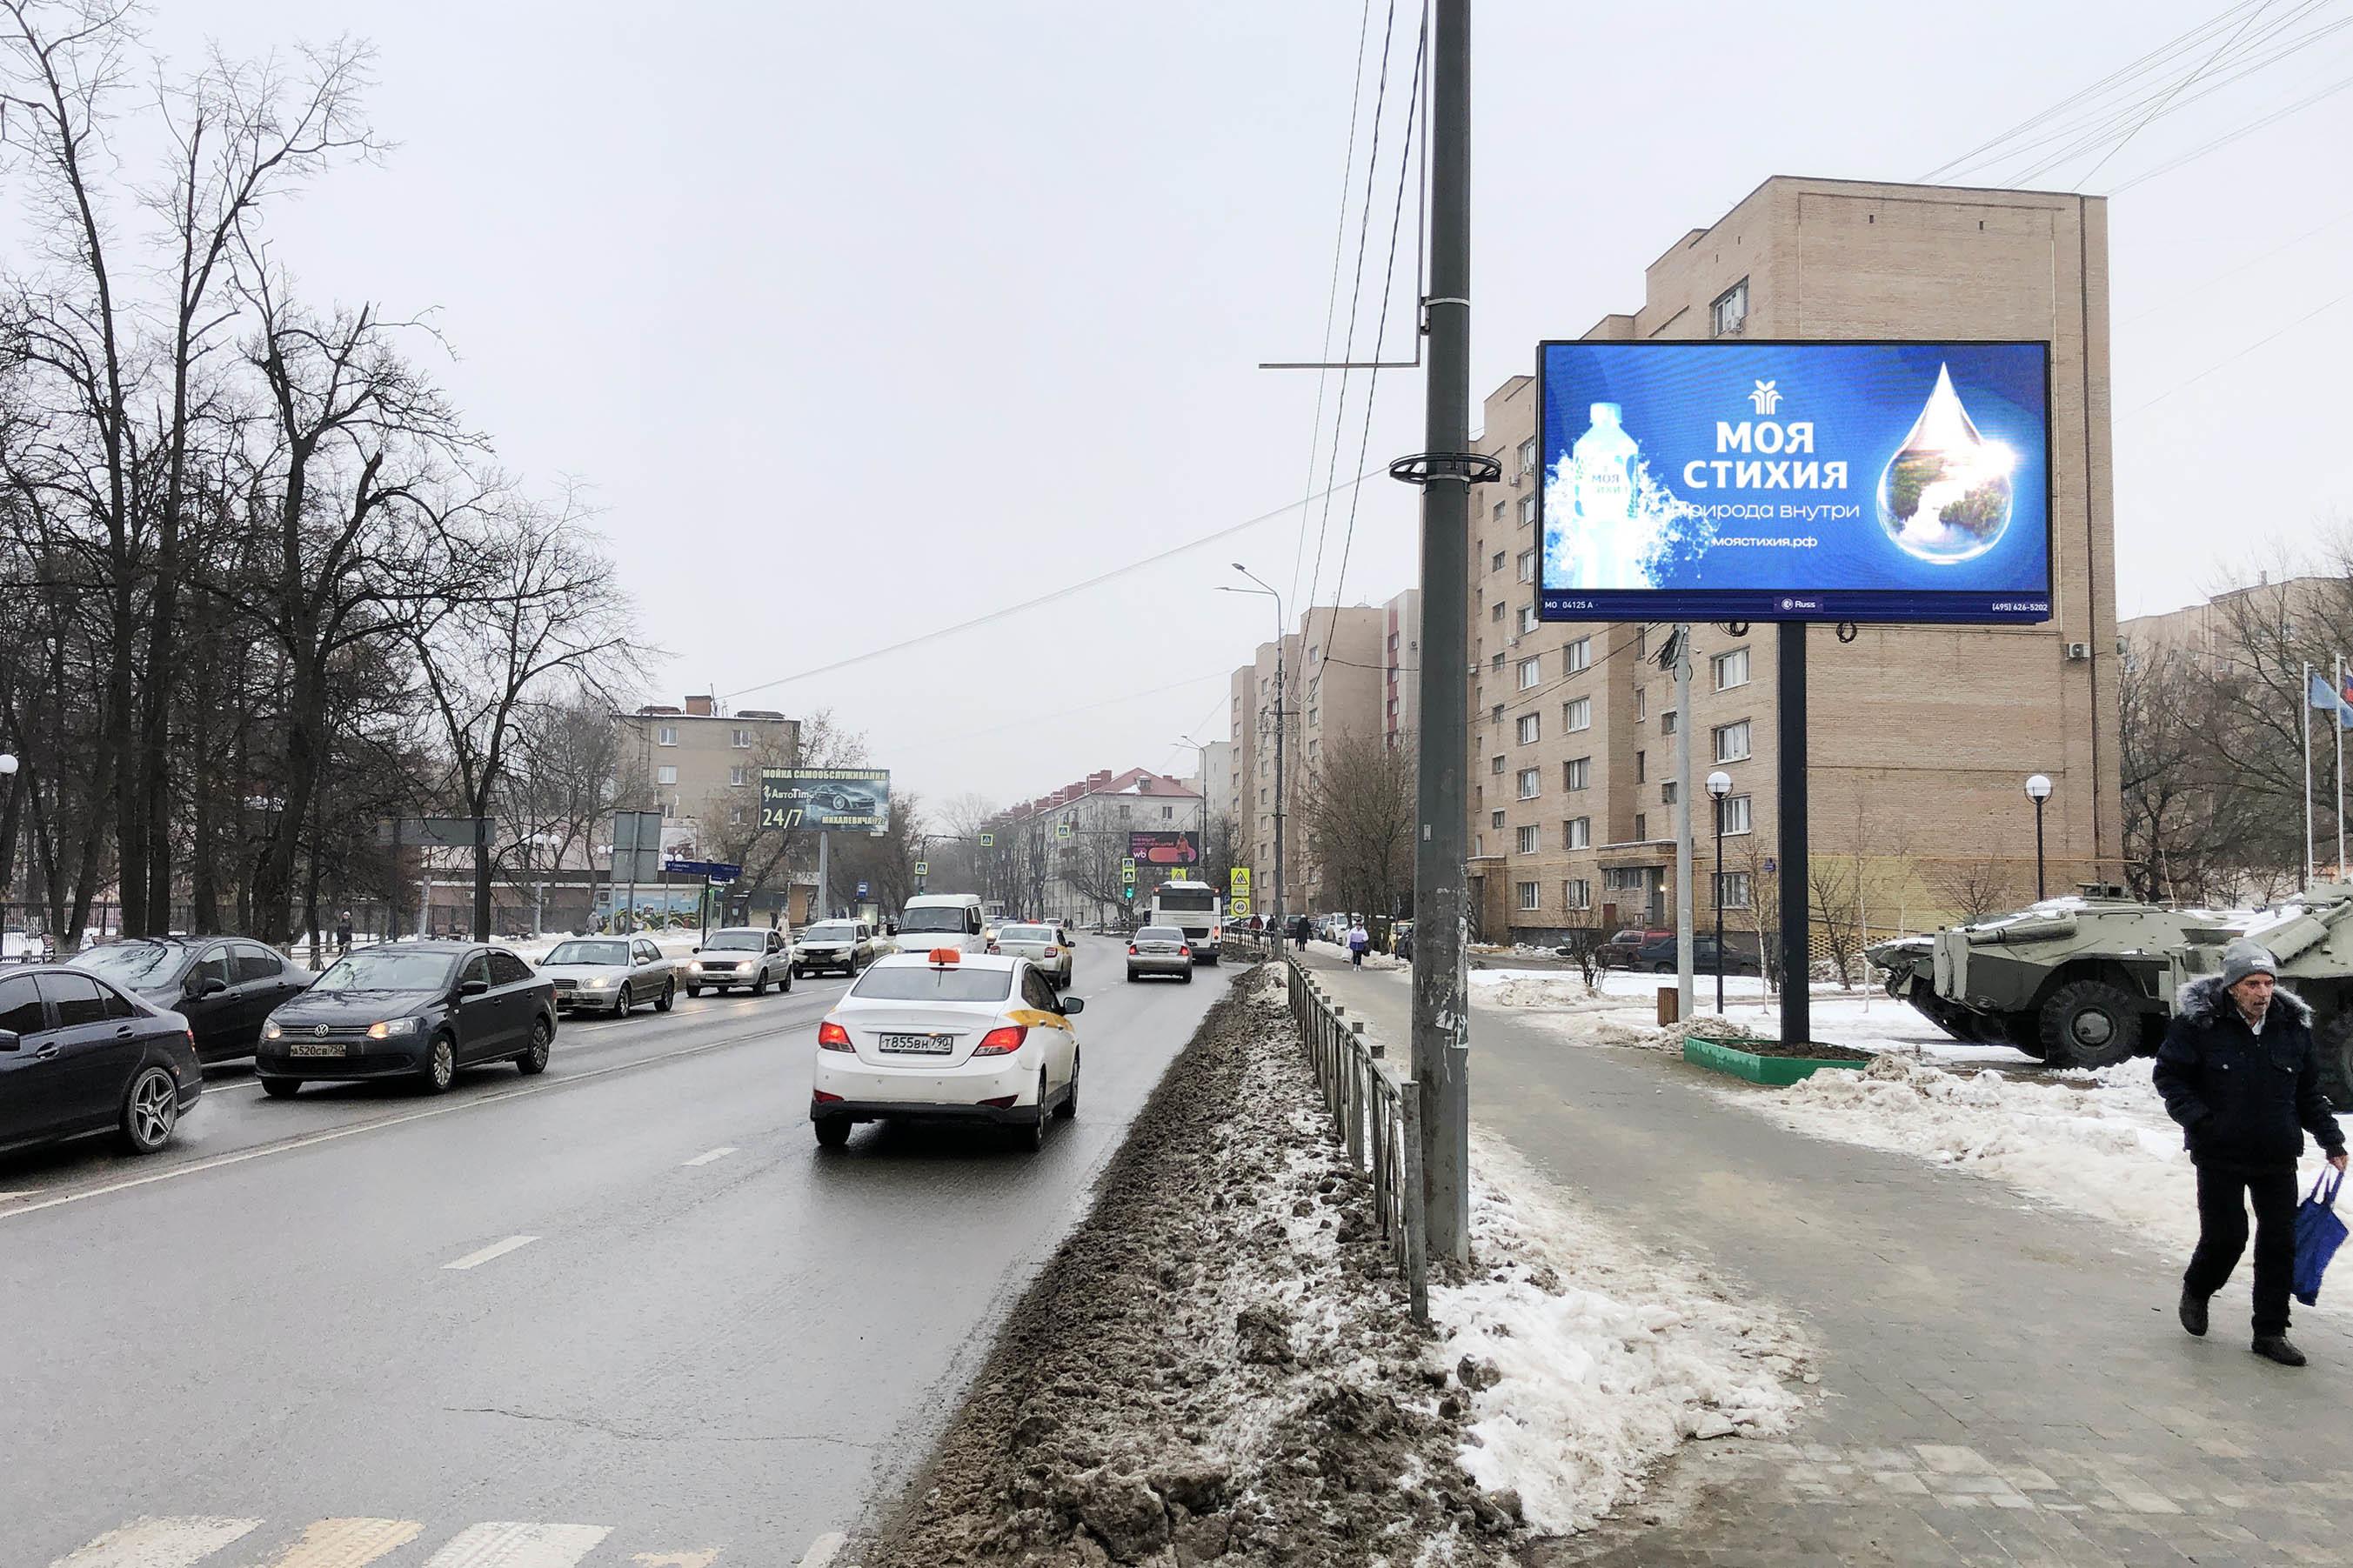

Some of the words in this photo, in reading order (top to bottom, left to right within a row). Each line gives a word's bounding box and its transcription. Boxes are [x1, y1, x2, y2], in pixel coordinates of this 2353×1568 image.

[1716, 421, 1814, 454] МОЯ
[1592, 474, 1620, 484] МОЯ
[1683, 460, 1848, 489] СТИХИЯ
[1683, 504, 1775, 522] рирода
[1780, 504, 1860, 522] внутри
[1713, 535, 1818, 549] моястихия.рф
[1992, 603, 2011, 611] (495)
[762, 768, 792, 779] МОЙКА
[793, 769, 886, 780] САМООБСЛУЖИВАНИЯ
[762, 808, 803, 829] 24/7
[931, 1037, 949, 1047] 790
